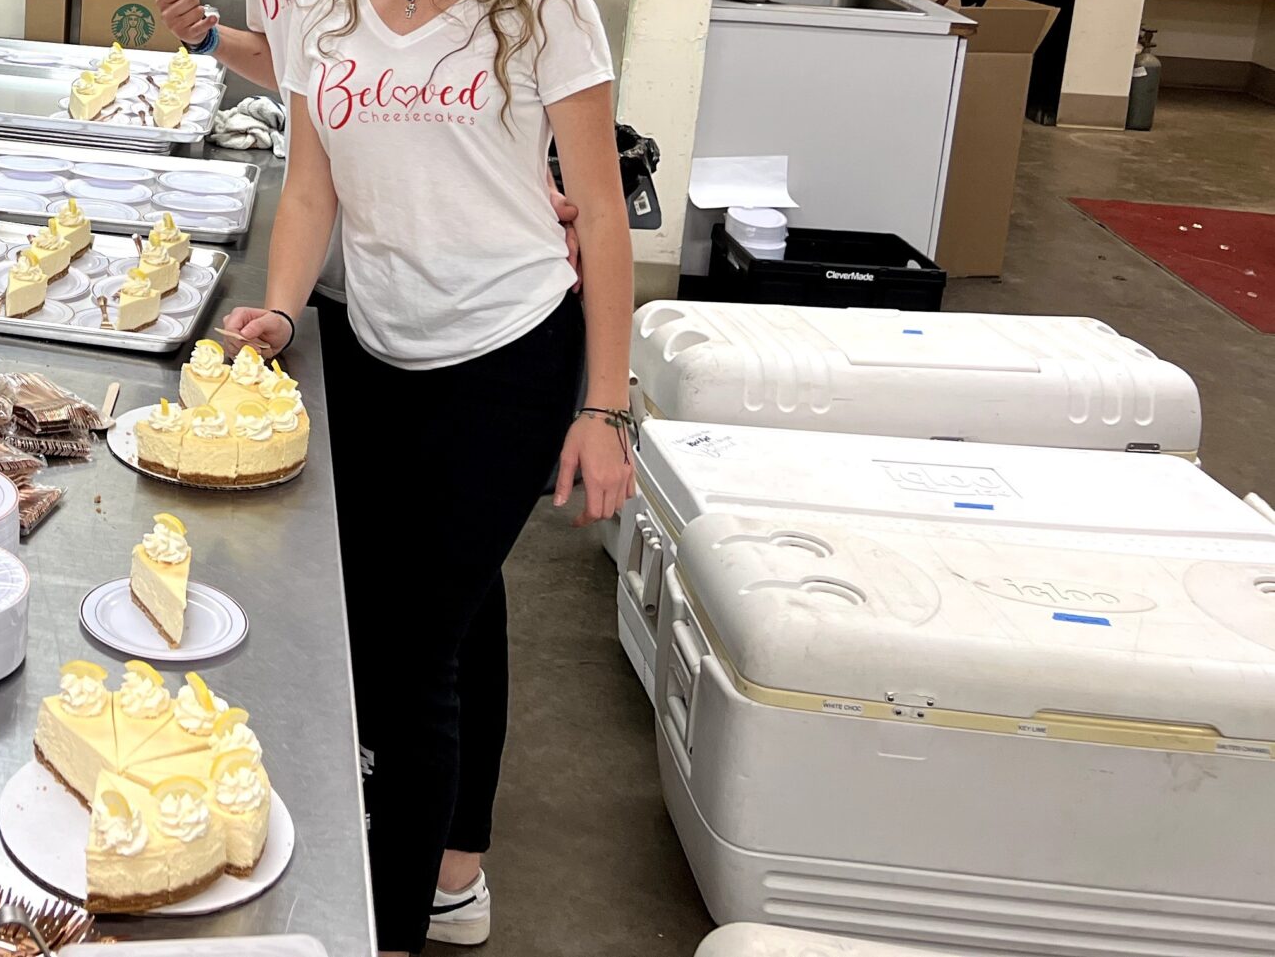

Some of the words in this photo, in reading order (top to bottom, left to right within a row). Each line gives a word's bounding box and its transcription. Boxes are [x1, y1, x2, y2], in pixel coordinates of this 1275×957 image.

[315, 59, 490, 130] Beloved
[357, 110, 476, 126] Cheesecakes
[826, 270, 874, 282] CleverMade
